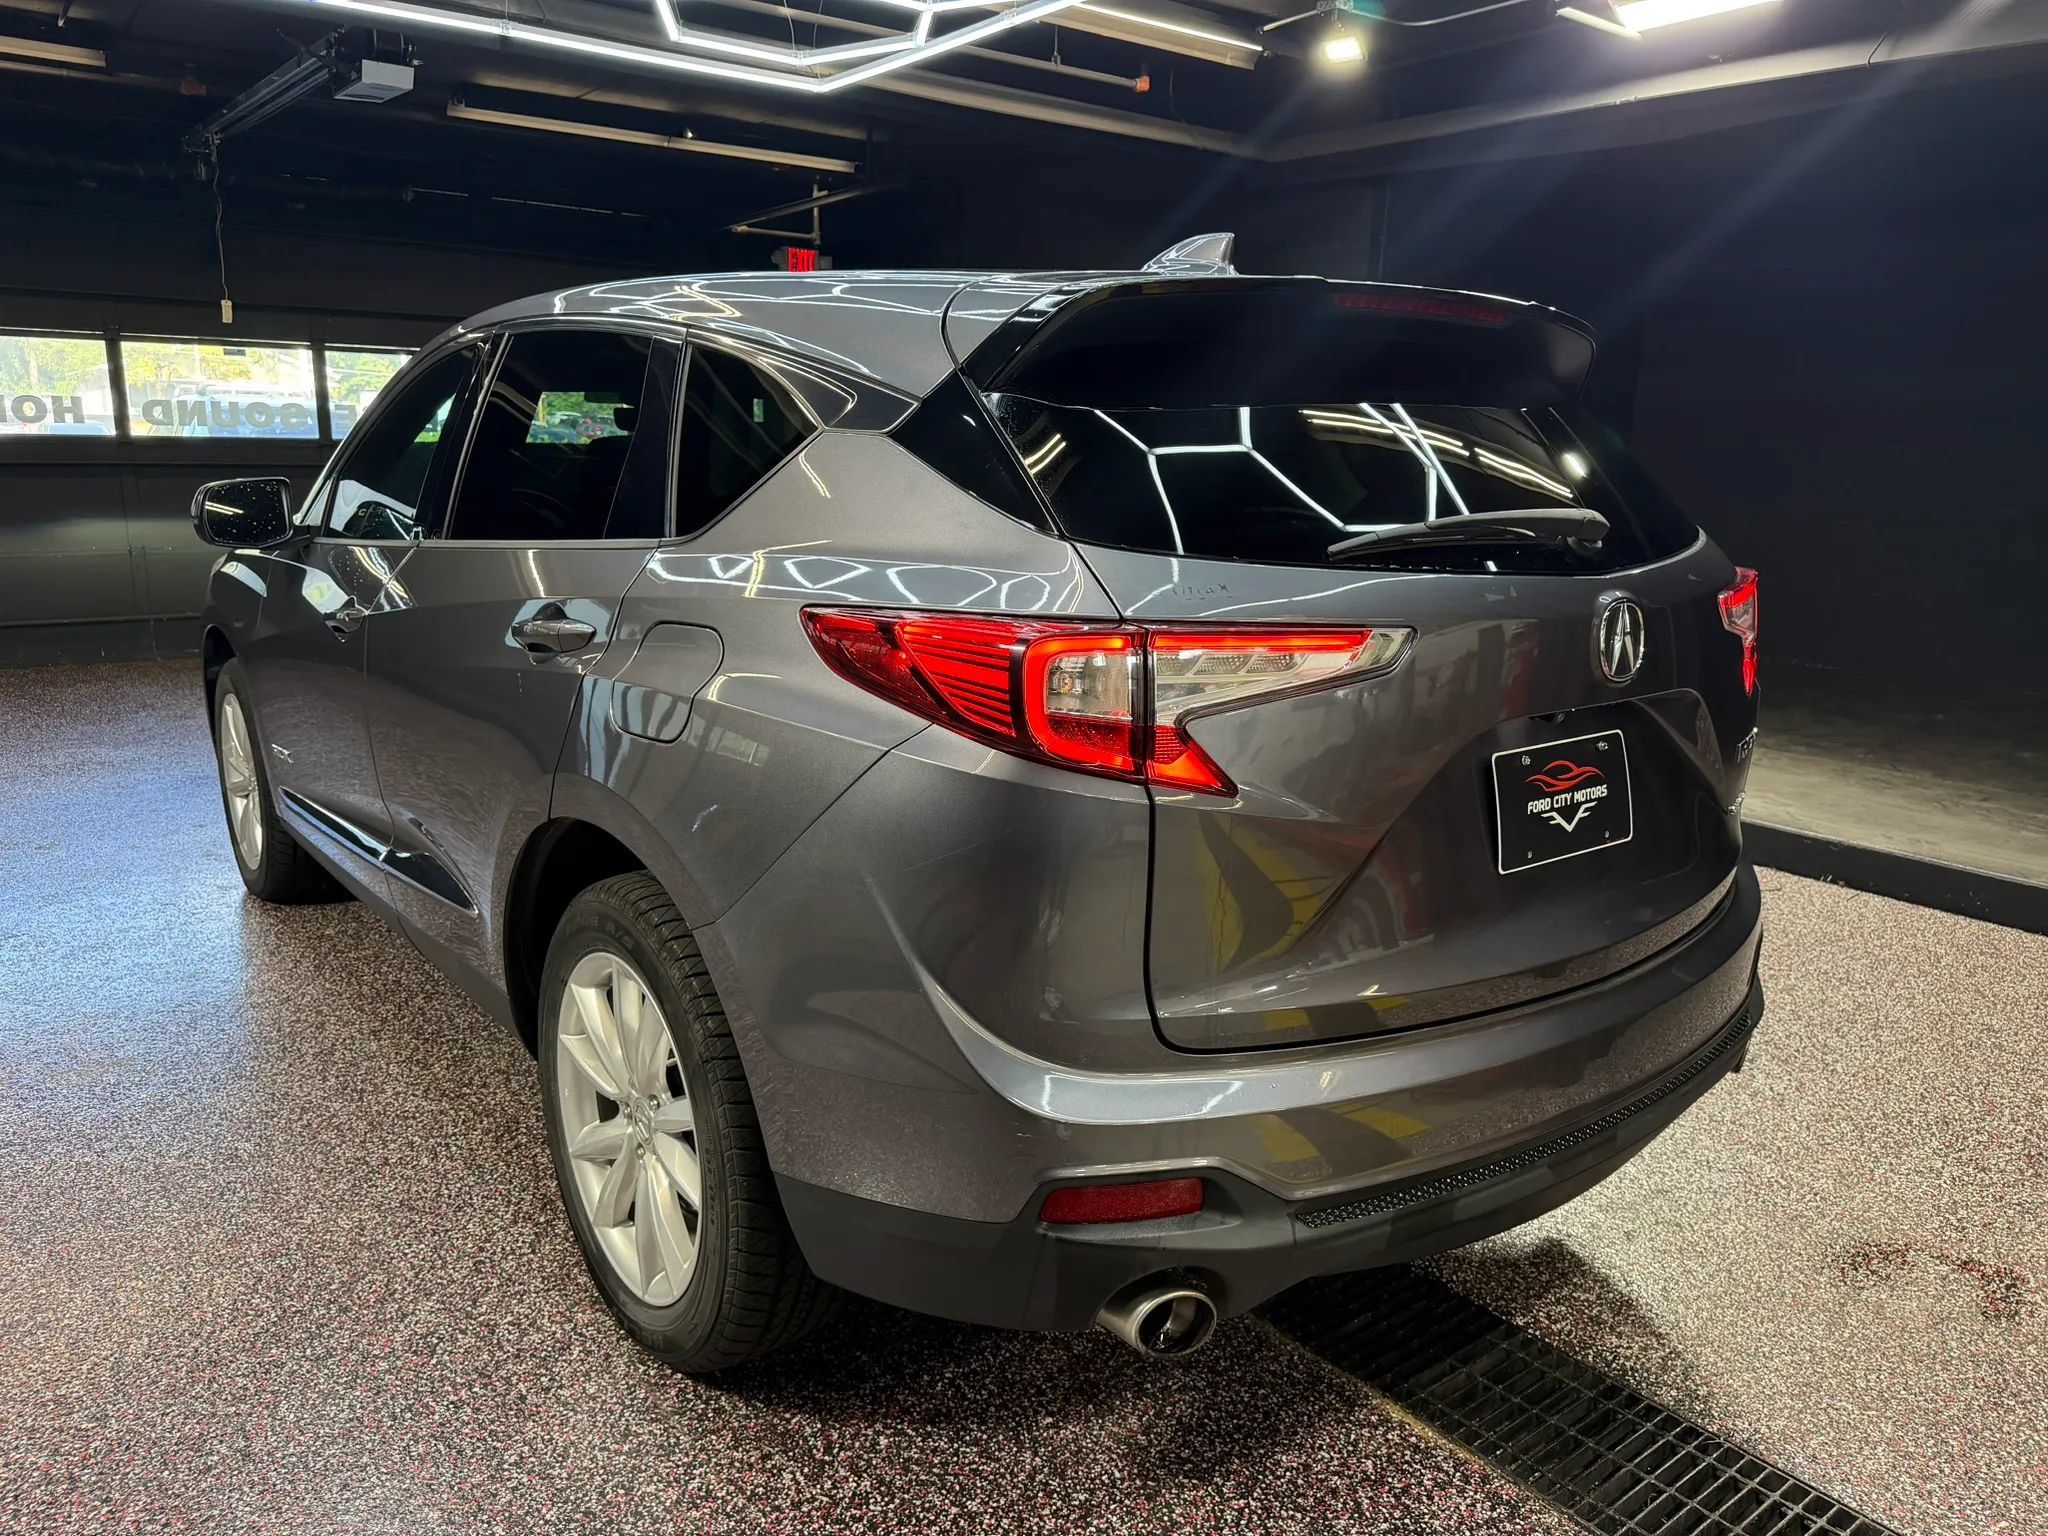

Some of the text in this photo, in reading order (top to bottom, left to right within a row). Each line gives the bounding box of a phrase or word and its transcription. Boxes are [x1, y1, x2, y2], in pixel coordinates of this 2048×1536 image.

[787, 247, 816, 272] EXIT
[1527, 784, 1608, 815] FORD CITY MOTORS
